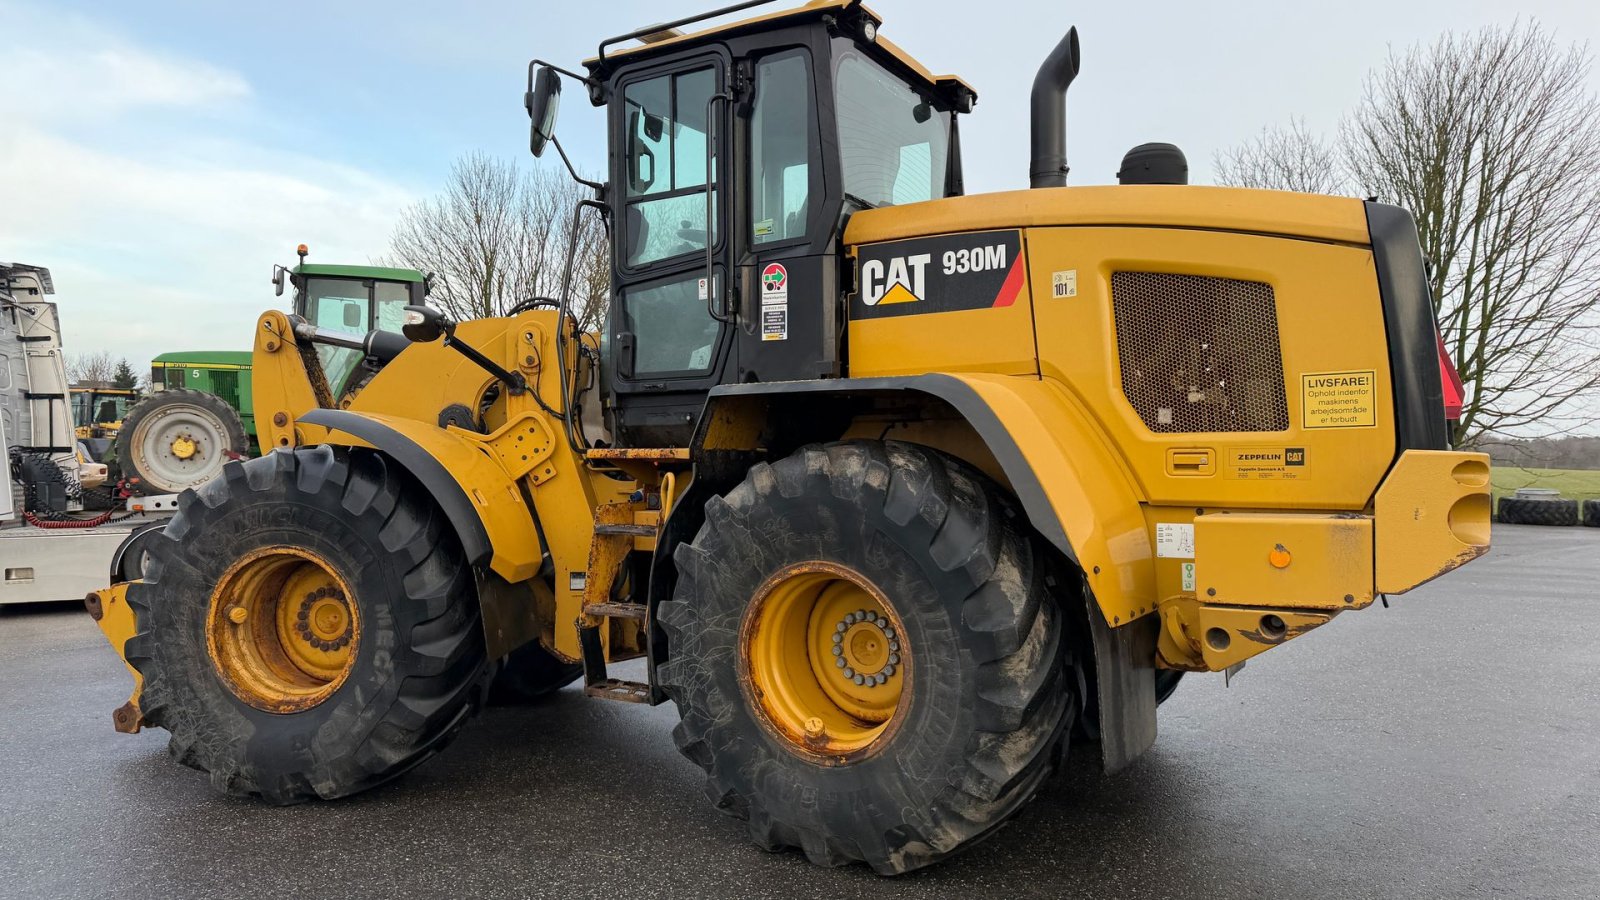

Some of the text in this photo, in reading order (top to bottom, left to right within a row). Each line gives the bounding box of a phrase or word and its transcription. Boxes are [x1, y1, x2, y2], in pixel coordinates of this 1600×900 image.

[862, 244, 1006, 306] CAT 930M
[1054, 283, 1067, 296] 101
[192, 369, 200, 378] 5
[1308, 377, 1369, 388] LIVSFARE!
[1308, 390, 1336, 398] Ophold
[1318, 398, 1359, 406] maskinens
[1310, 406, 1368, 416] arbejdsområde
[1287, 452, 1303, 462] CAT
